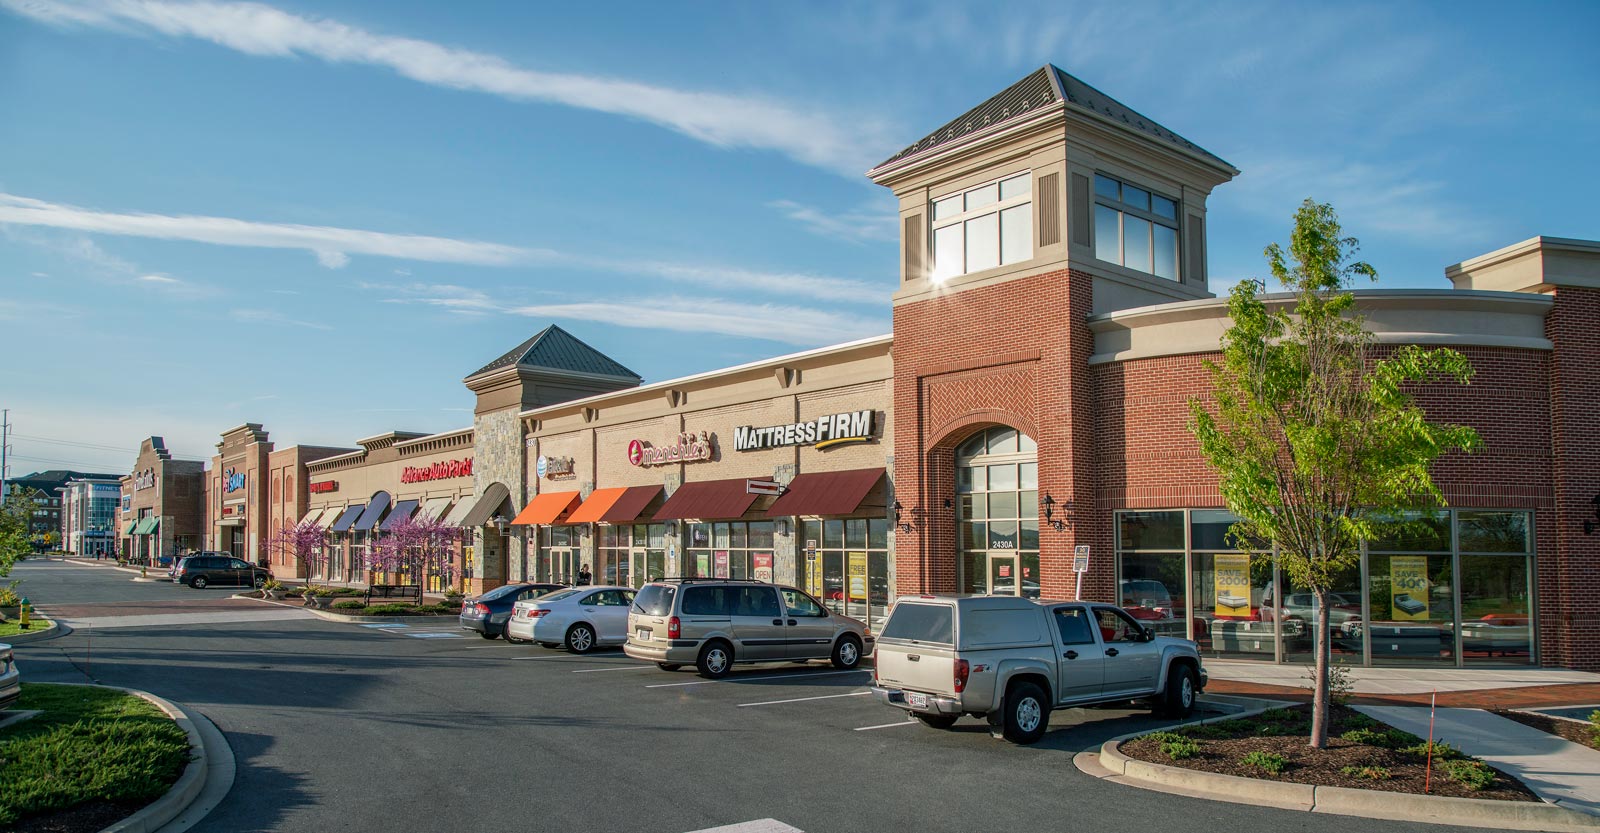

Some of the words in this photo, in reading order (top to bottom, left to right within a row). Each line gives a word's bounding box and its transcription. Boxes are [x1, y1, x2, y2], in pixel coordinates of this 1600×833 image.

[429, 461, 449, 480] Auto
[448, 458, 473, 478] Parts
[992, 540, 1013, 549] 2430A
[755, 570, 771, 580] OPEN
[1217, 569, 1240, 577] SAVE
[1394, 570, 1418, 578] SAVE
